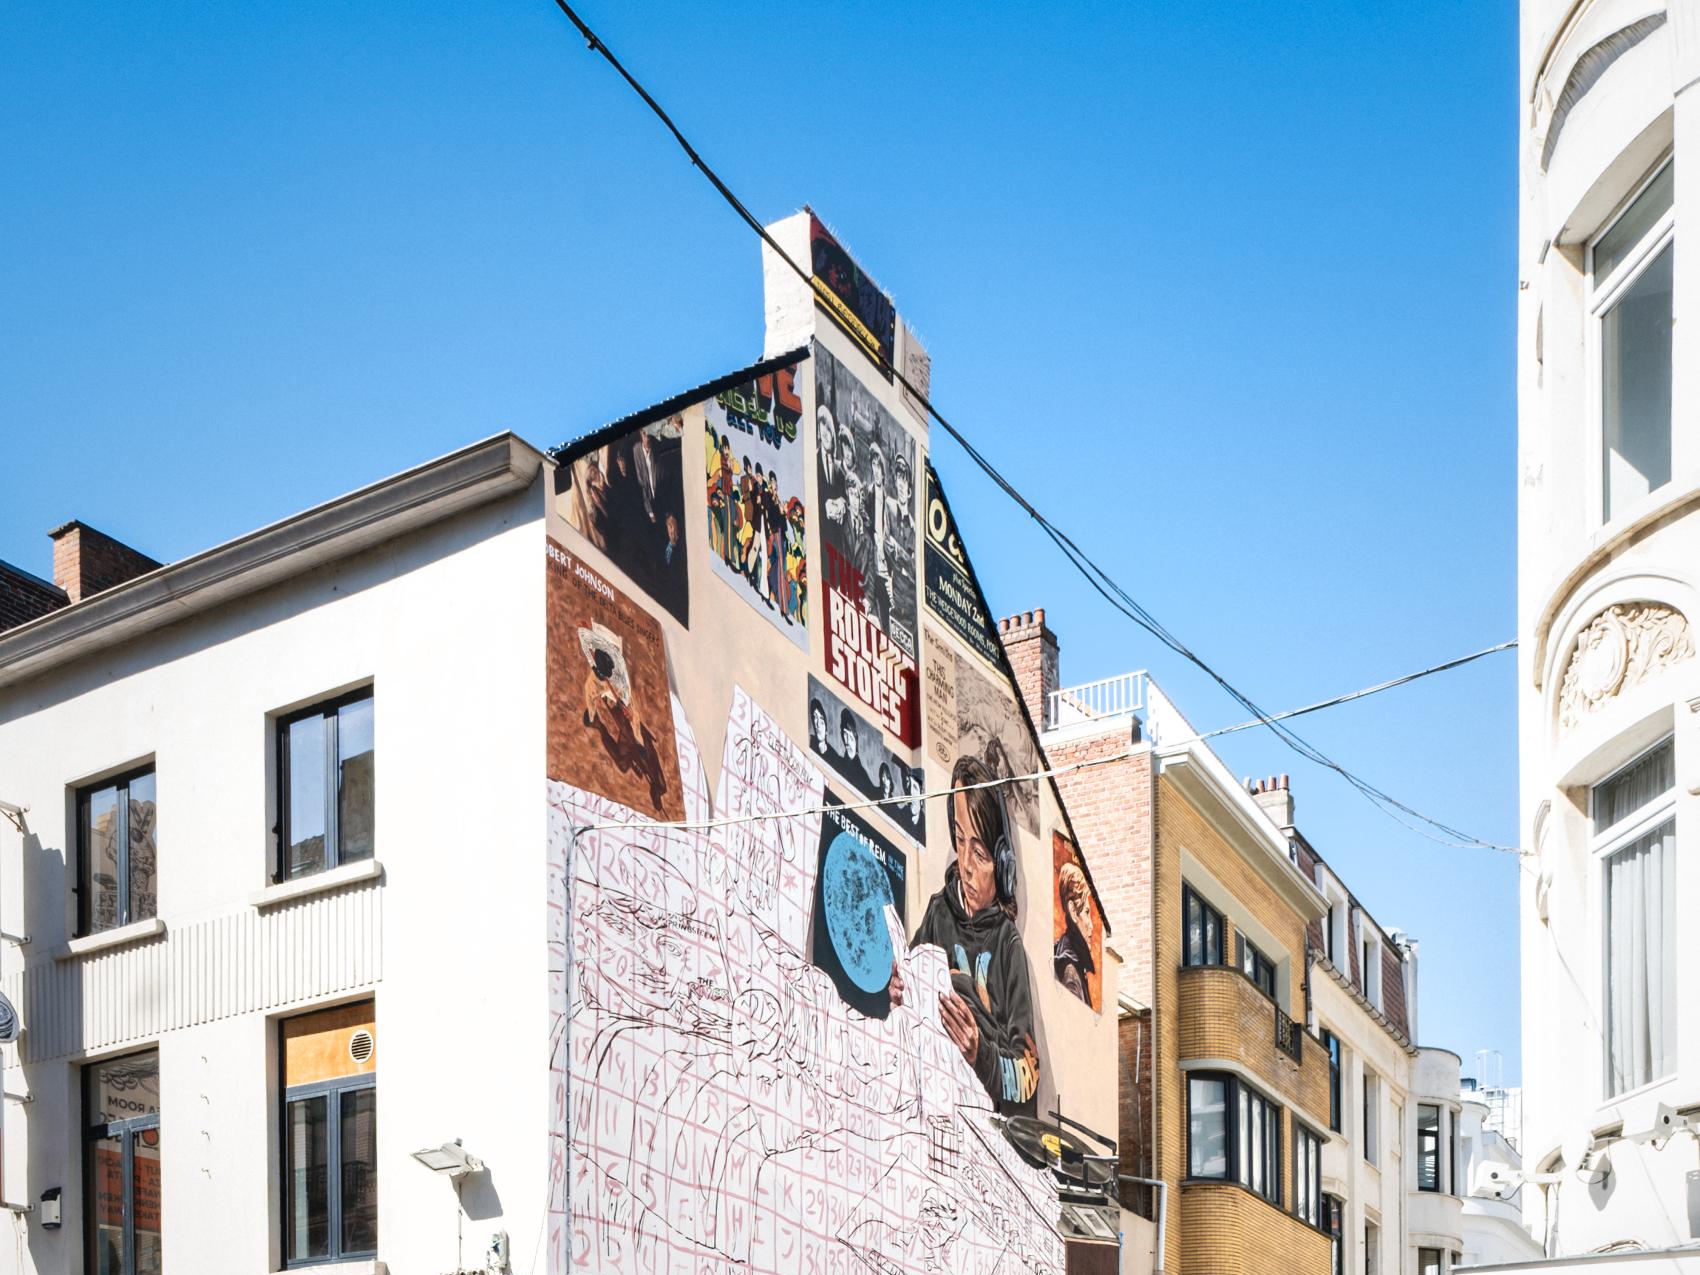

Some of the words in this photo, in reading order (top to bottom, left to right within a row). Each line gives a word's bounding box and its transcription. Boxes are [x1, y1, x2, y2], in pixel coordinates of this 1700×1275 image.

[575, 564, 615, 601] JOHNSON
[825, 541, 865, 606] THE
[925, 585, 938, 605] THE
[939, 575, 973, 617] MONDAY
[829, 587, 915, 701] ROLLING
[831, 632, 902, 737] STONES
[926, 667, 954, 699] CHARMING
[933, 659, 946, 680] THIS
[934, 686, 947, 705] MAN
[841, 815, 860, 840] BEST
[869, 838, 887, 866] REM
[697, 977, 714, 987] THE
[605, 1162, 625, 1197] 6
[806, 1188, 824, 1225] 29
[572, 1229, 592, 1267] 2
